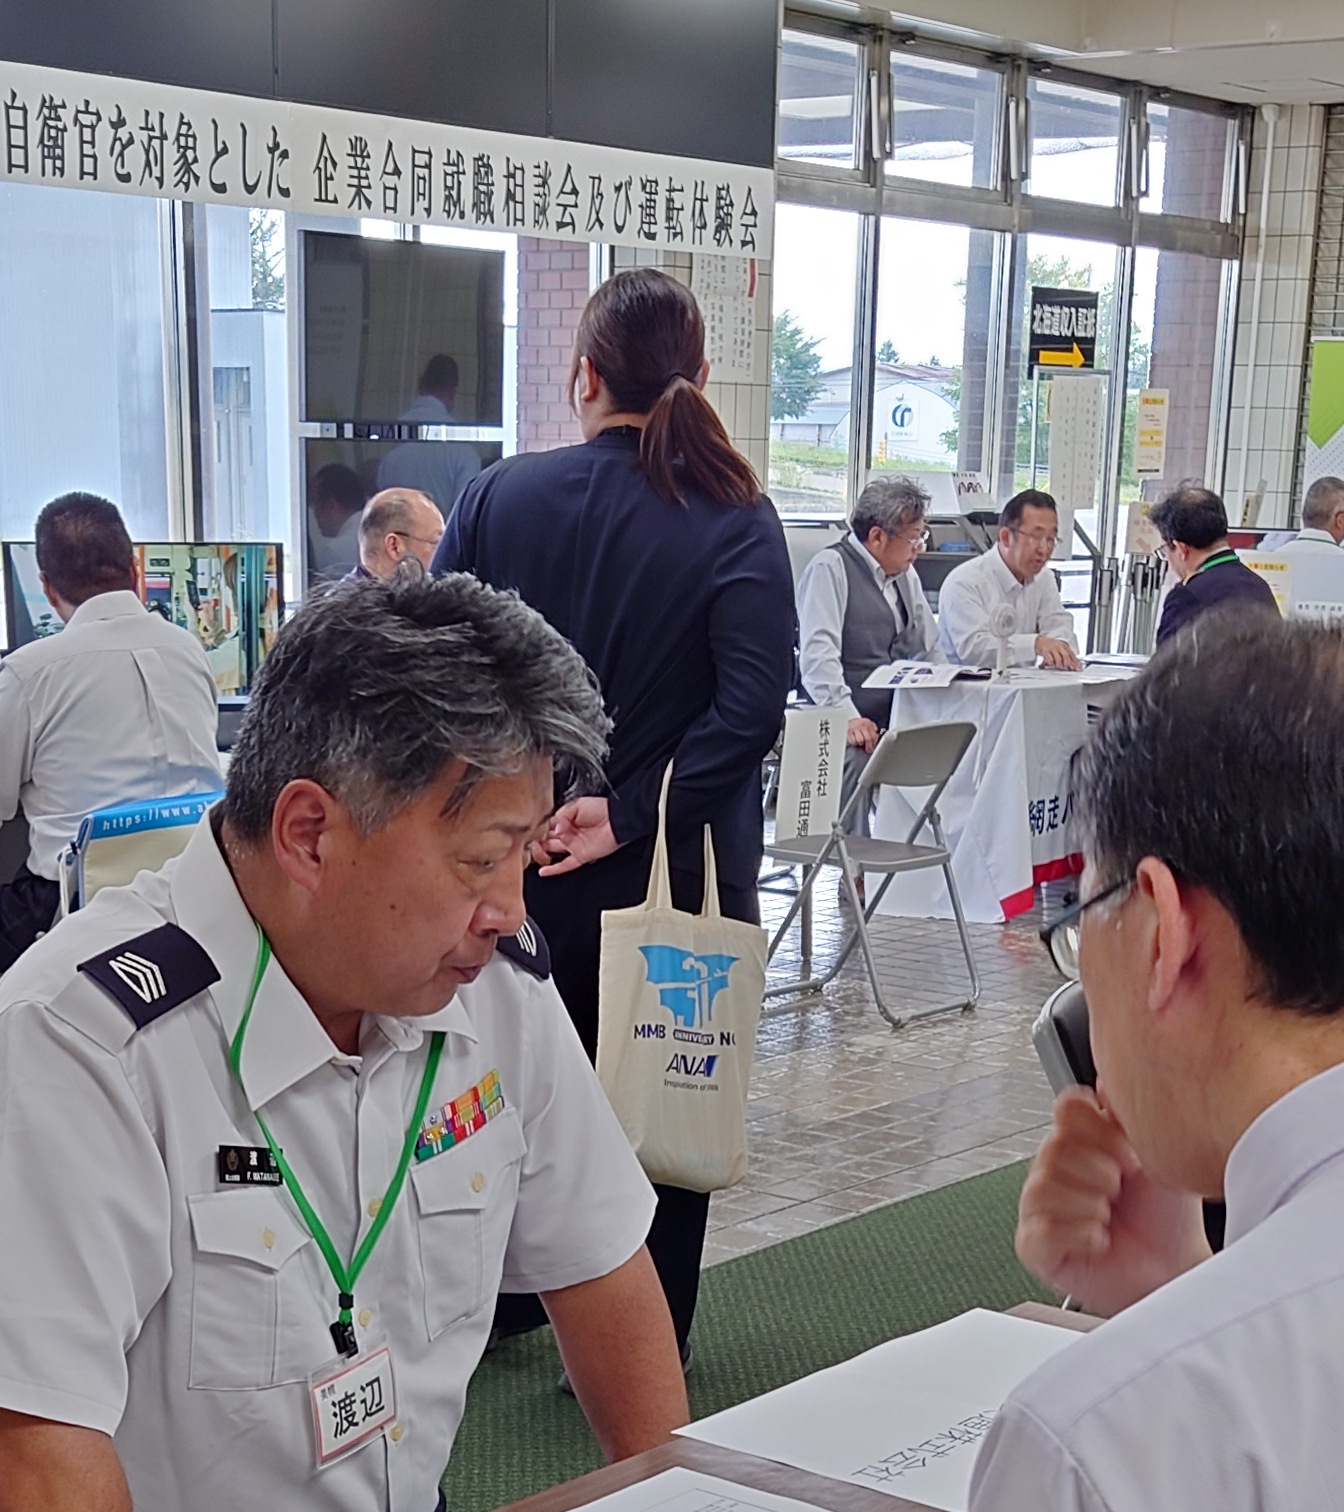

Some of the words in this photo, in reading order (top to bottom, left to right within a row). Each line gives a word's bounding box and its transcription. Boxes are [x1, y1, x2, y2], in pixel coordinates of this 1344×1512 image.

[2, 88, 292, 202] 自衛官を対象とした
[313, 130, 759, 253] 企業合同就職相談会及び運転体験会
[816, 719, 831, 797] 株式会社
[634, 1024, 666, 1039] MMB
[666, 1053, 709, 1077] ANA
[331, 1376, 385, 1439] 渡辺
[851, 1404, 1002, 1483] 通株式会社
